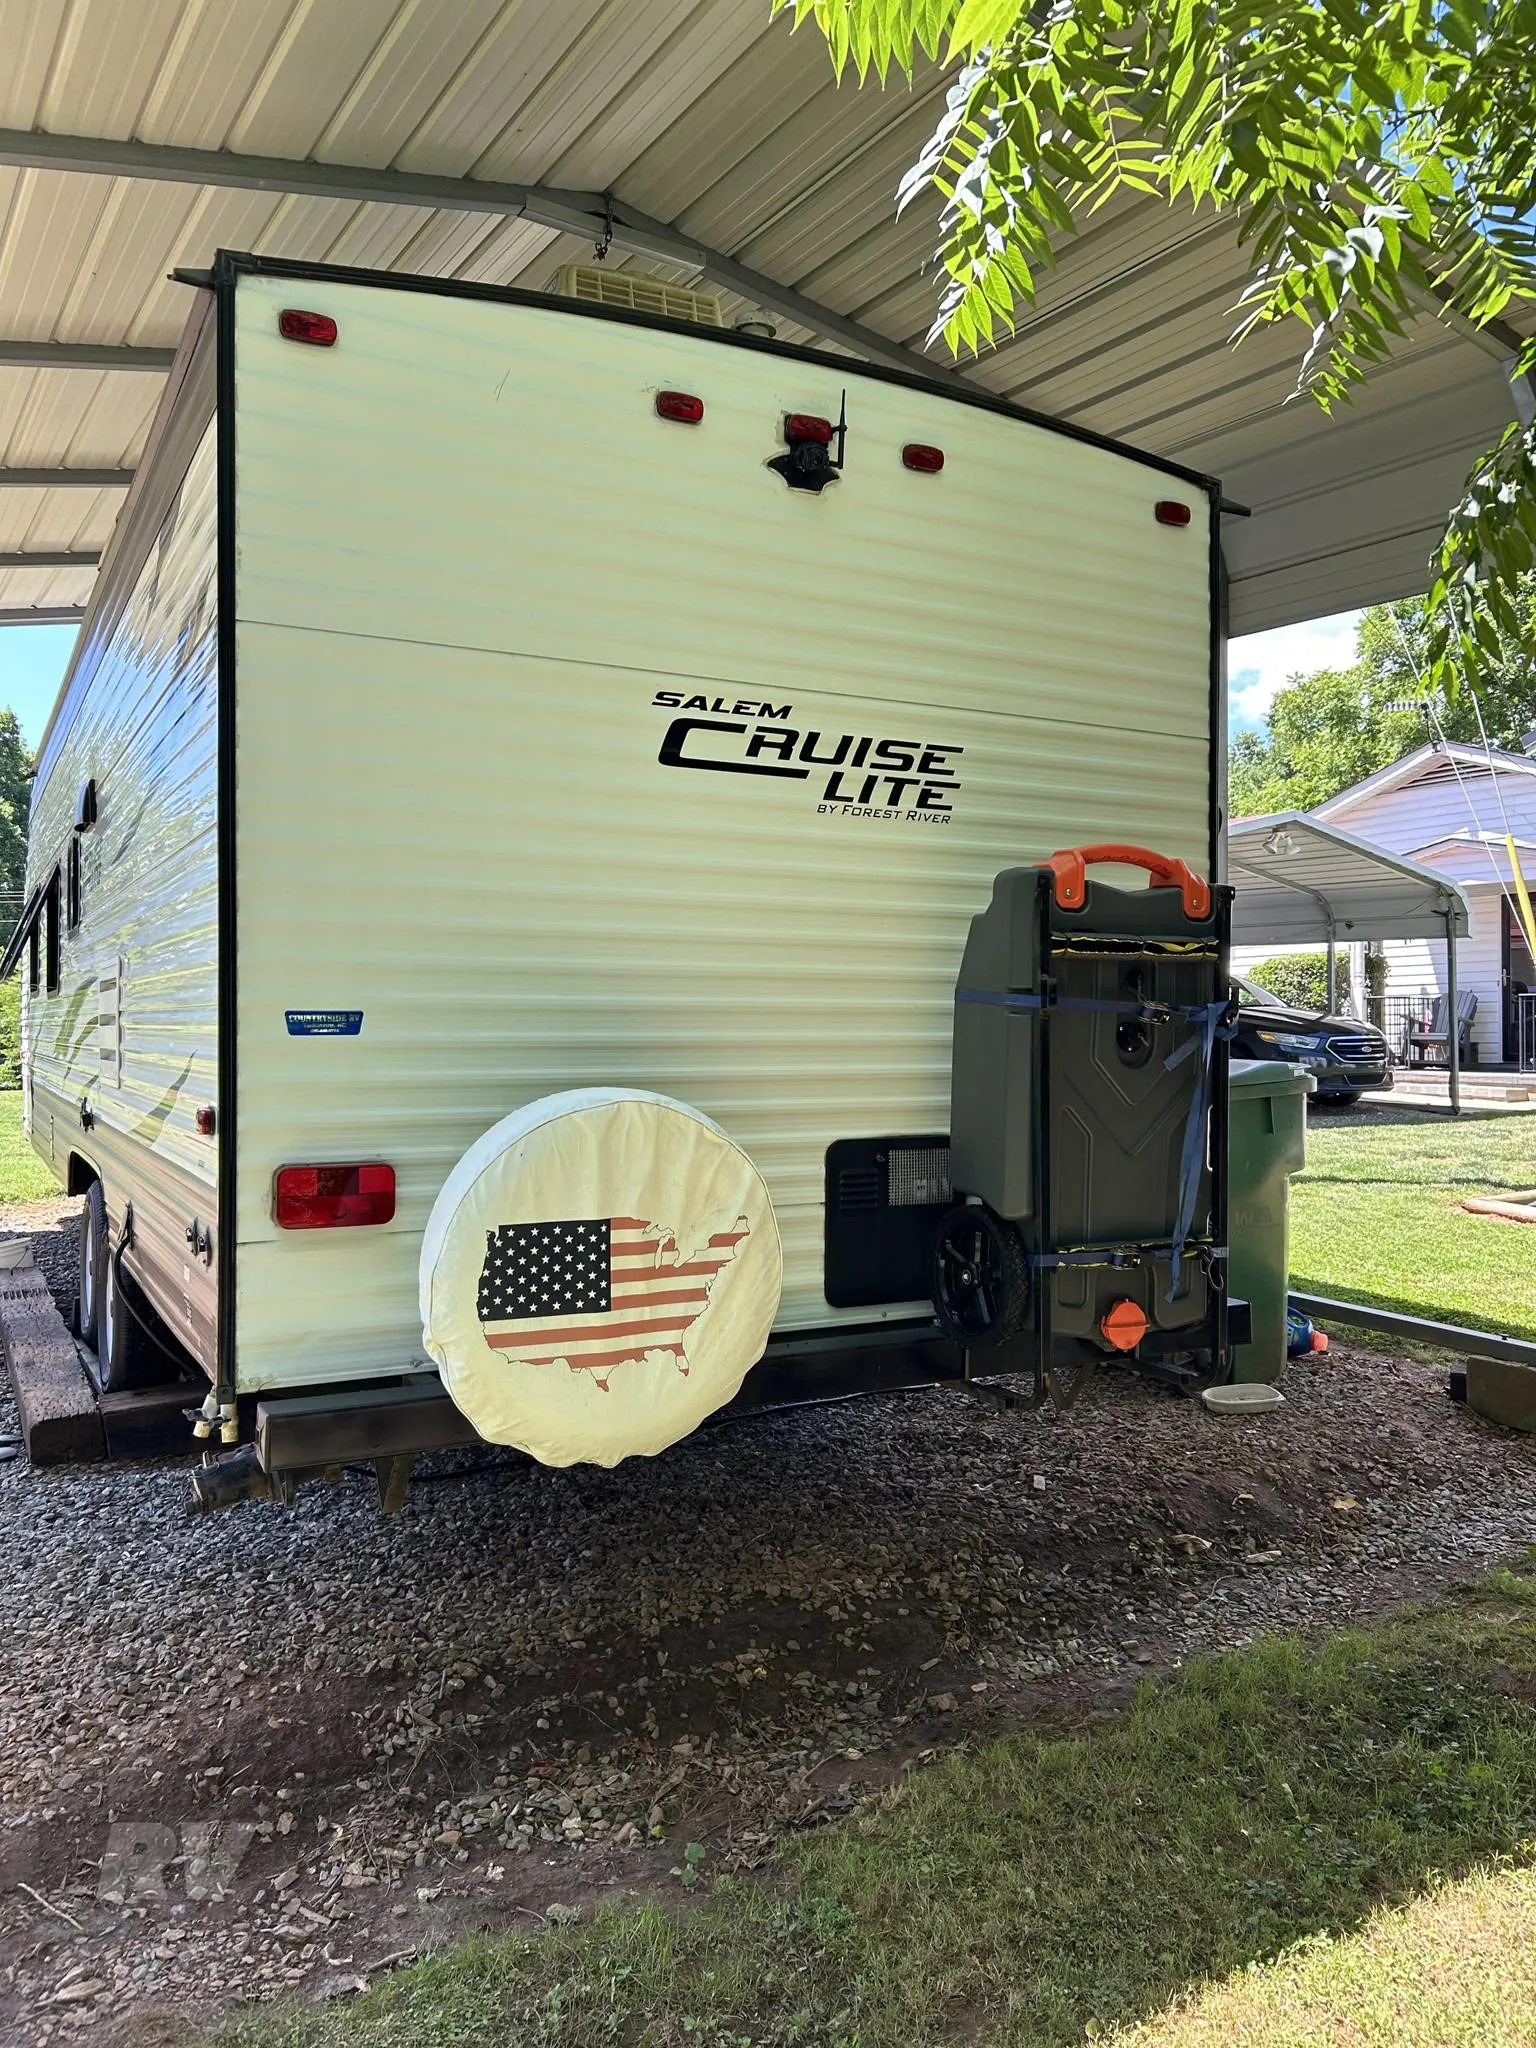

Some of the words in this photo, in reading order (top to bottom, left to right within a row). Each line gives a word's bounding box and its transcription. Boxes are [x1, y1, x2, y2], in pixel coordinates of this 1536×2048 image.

[652, 691, 793, 720] SALEM
[657, 717, 965, 780] CRUISE
[823, 771, 962, 812] LITE
[817, 803, 838, 814] BY
[841, 804, 903, 820] FOREST
[906, 810, 951, 824] RIVER
[288, 1014, 347, 1022] COUNTRYSIDE
